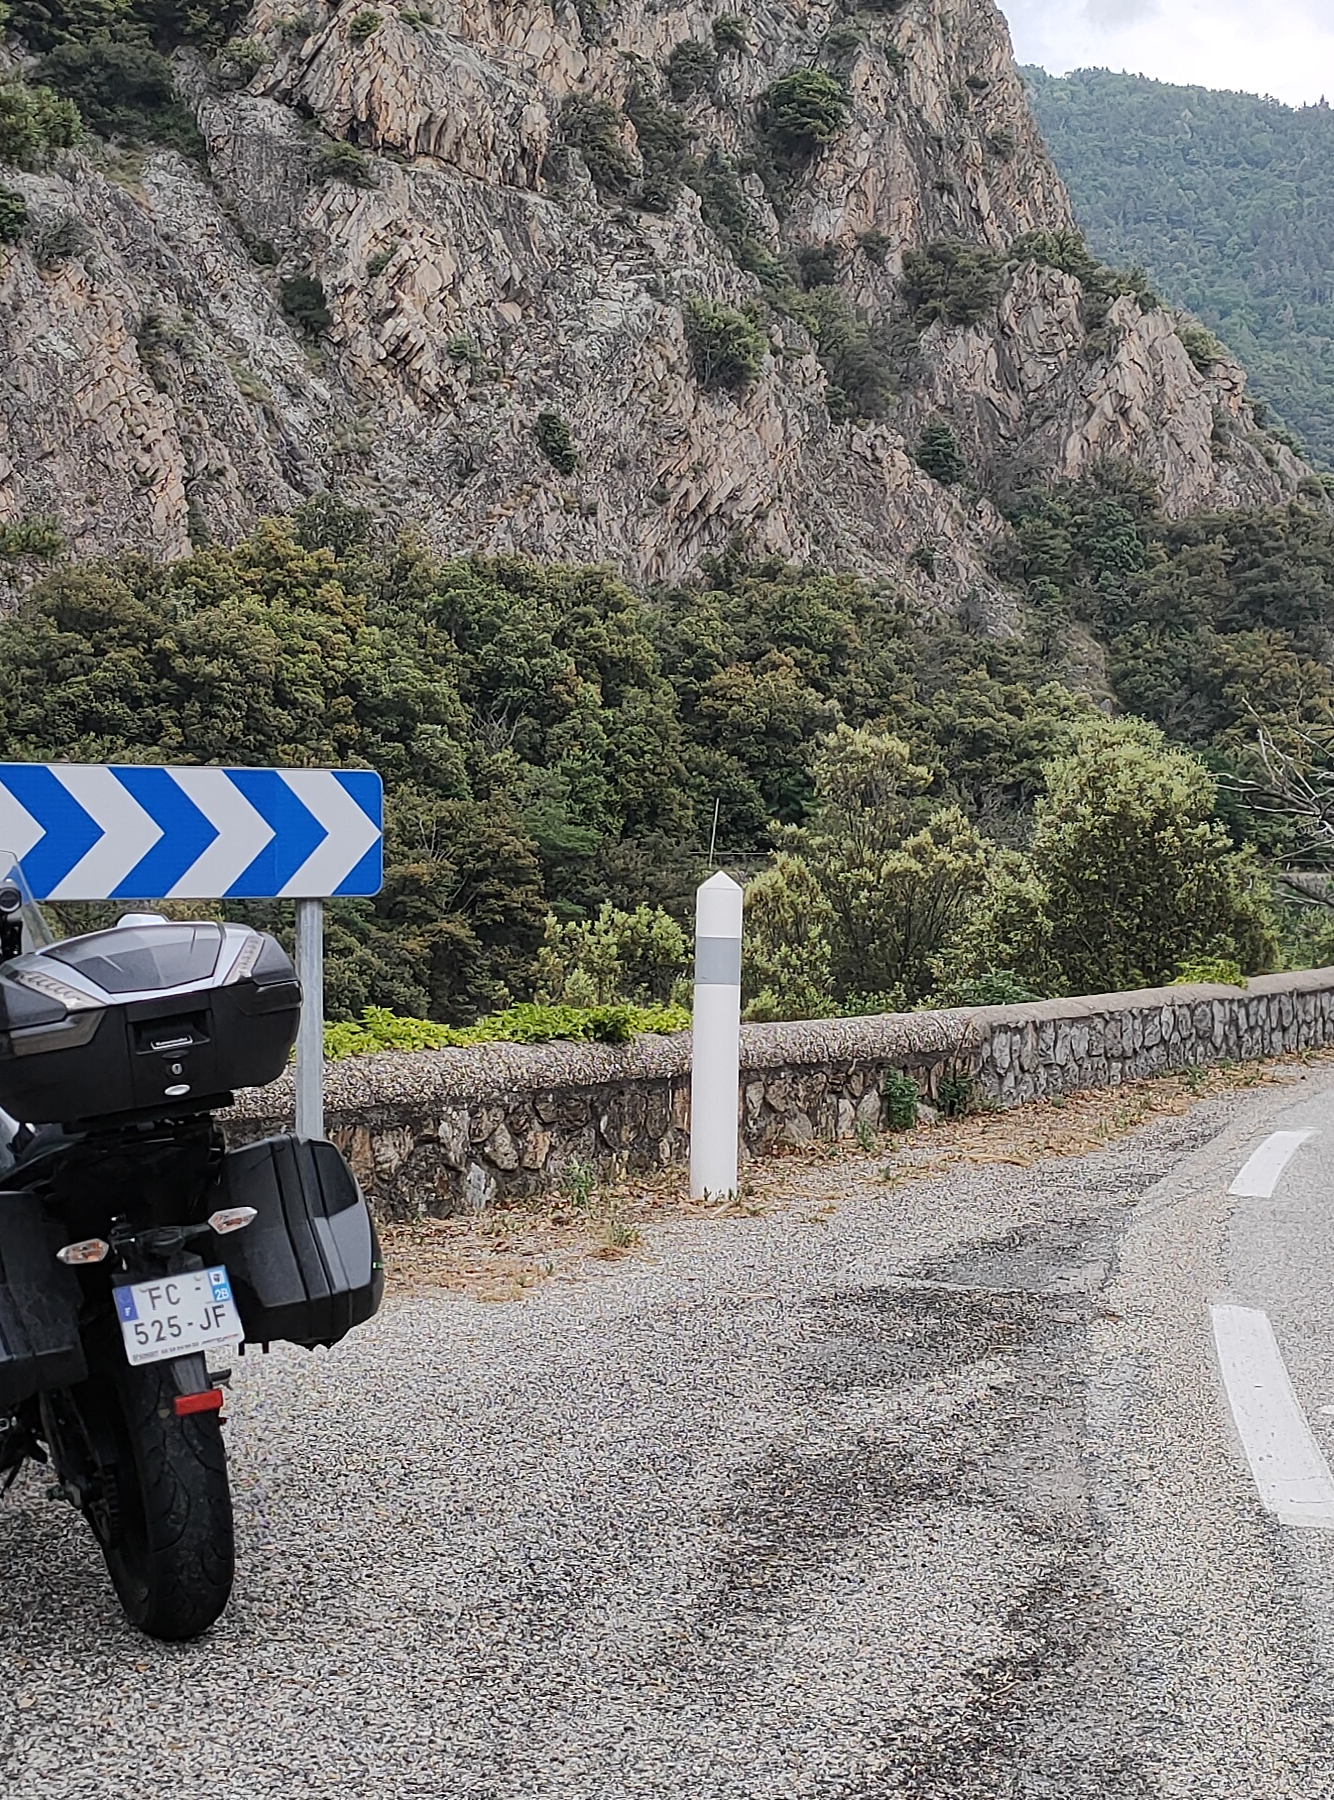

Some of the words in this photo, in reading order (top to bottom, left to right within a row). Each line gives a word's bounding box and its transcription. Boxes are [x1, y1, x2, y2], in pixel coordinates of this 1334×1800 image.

[148, 1284, 181, 1310] FC
[214, 1287, 230, 1301] 2B
[134, 1304, 226, 1345] 525-JF
